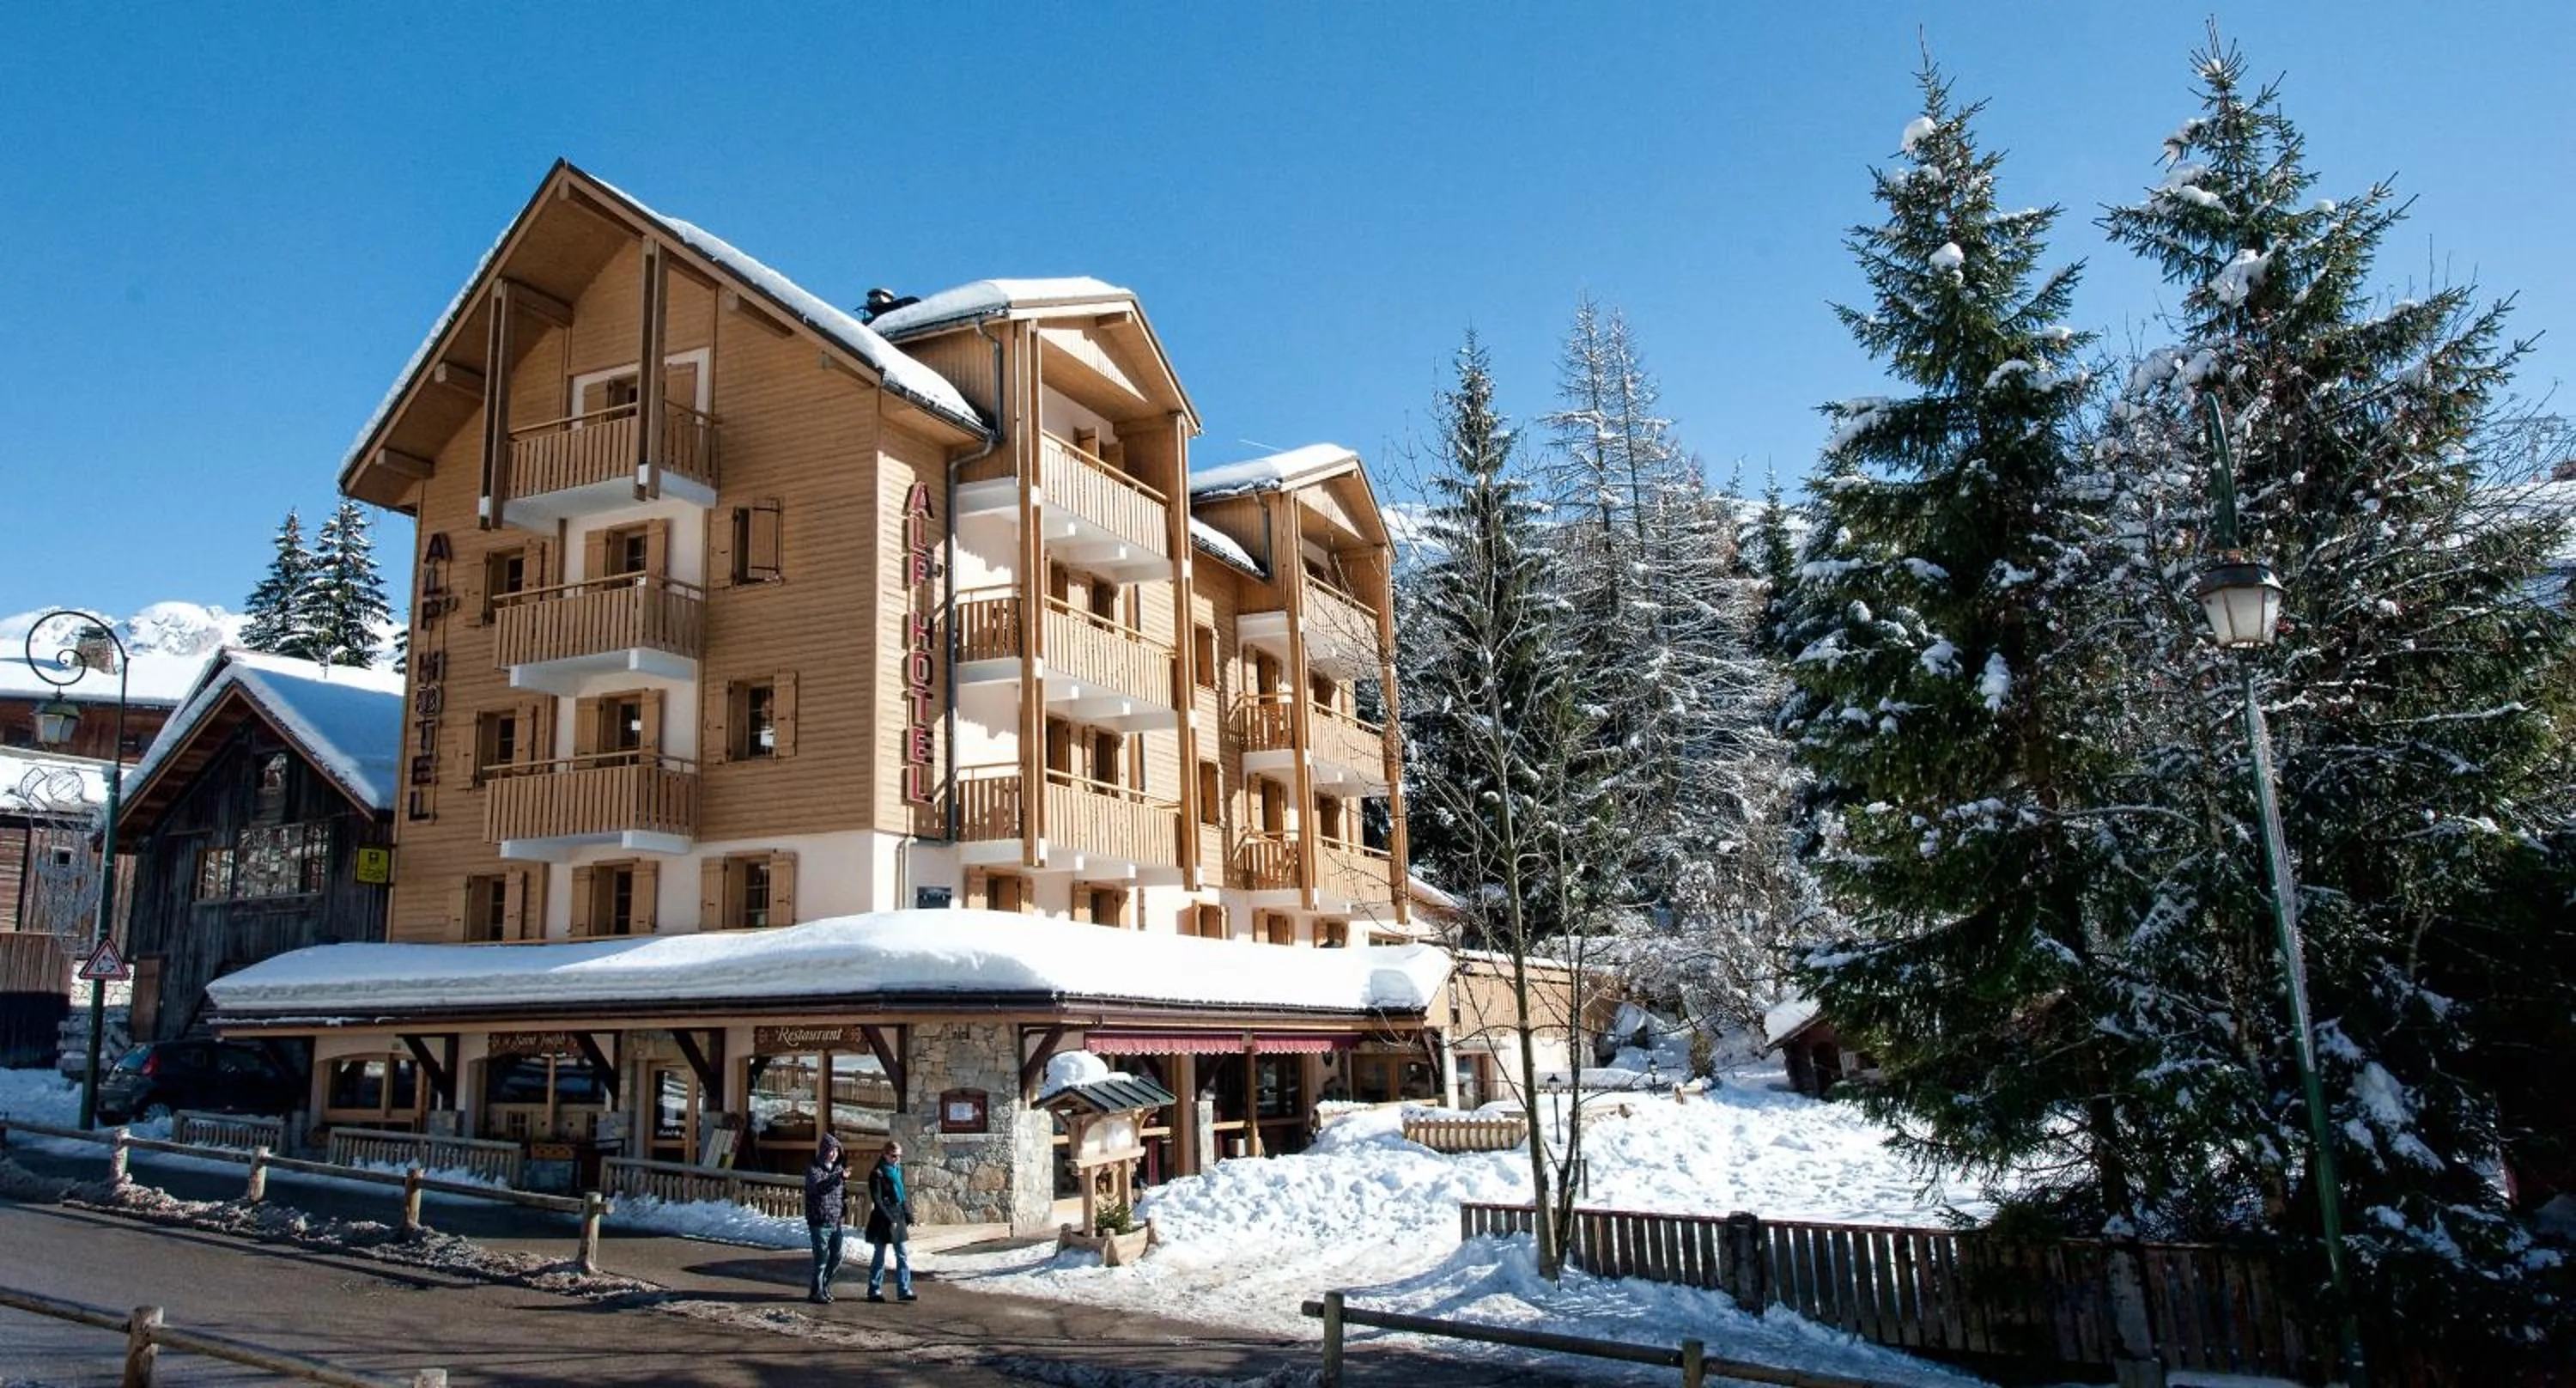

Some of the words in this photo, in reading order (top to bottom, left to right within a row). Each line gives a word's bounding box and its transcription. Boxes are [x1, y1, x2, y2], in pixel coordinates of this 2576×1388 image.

[421, 533, 452, 630] ALP
[905, 481, 934, 589] ALP
[409, 650, 444, 822] HOTEL
[905, 611, 934, 803] HOTEL
[775, 1026, 842, 1046] Restaurant
